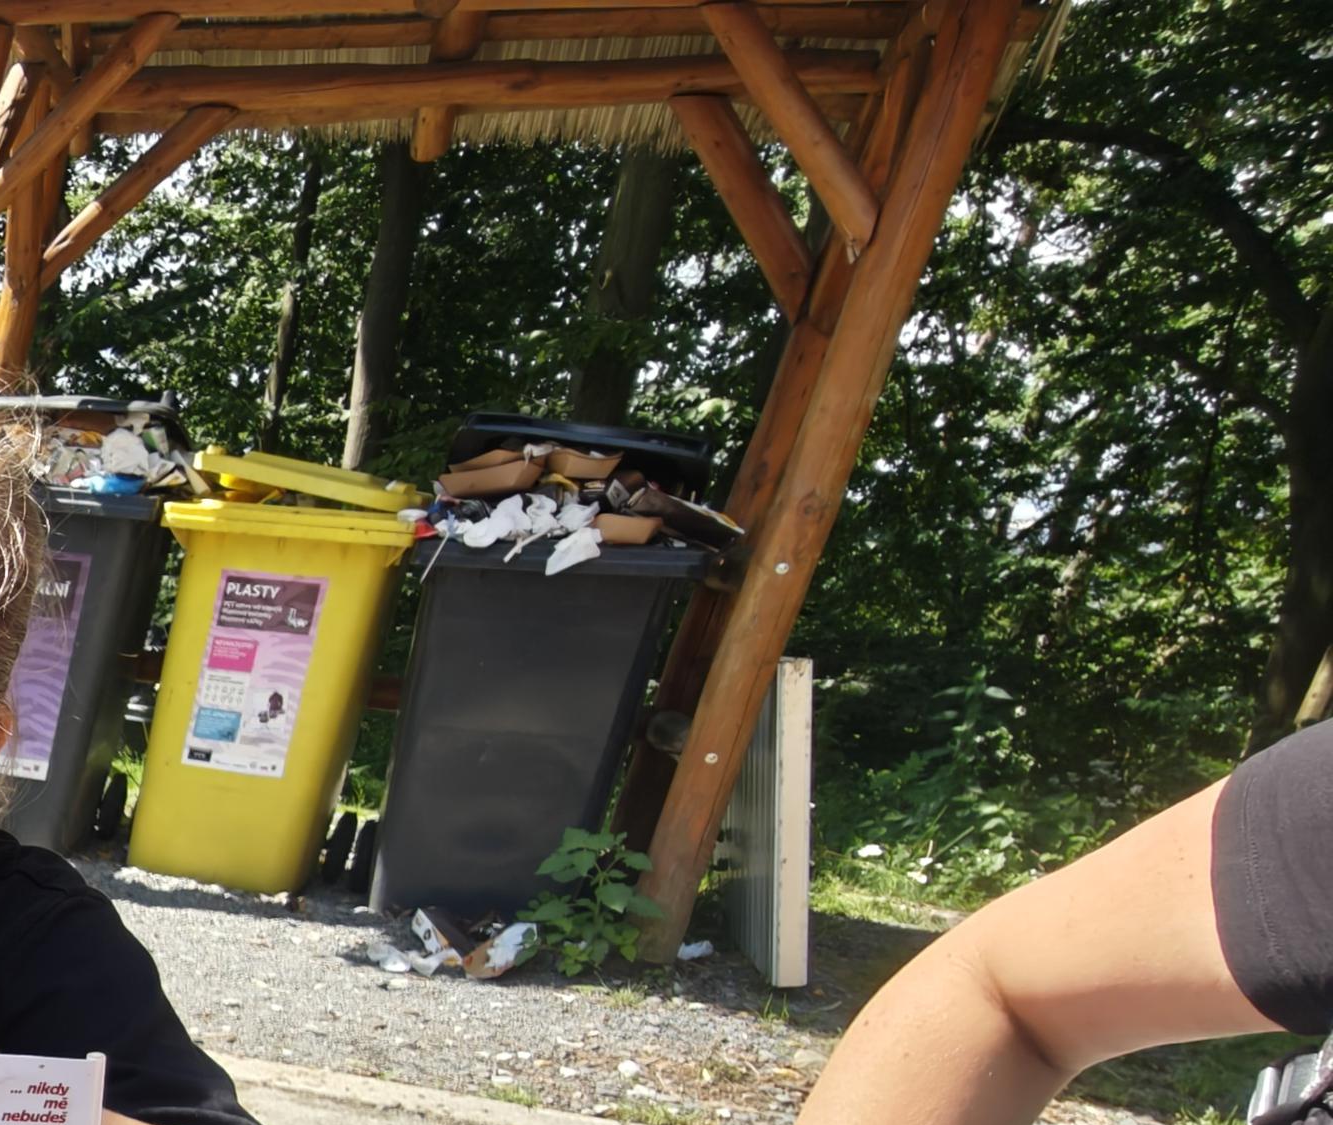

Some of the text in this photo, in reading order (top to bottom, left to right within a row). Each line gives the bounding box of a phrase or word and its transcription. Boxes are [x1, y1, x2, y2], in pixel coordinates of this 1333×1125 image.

[225, 582, 281, 599] PLASTY
[27, 1082, 70, 1096] nikdy
[43, 1097, 69, 1110] mě
[1, 1110, 68, 1124] nebudeš
